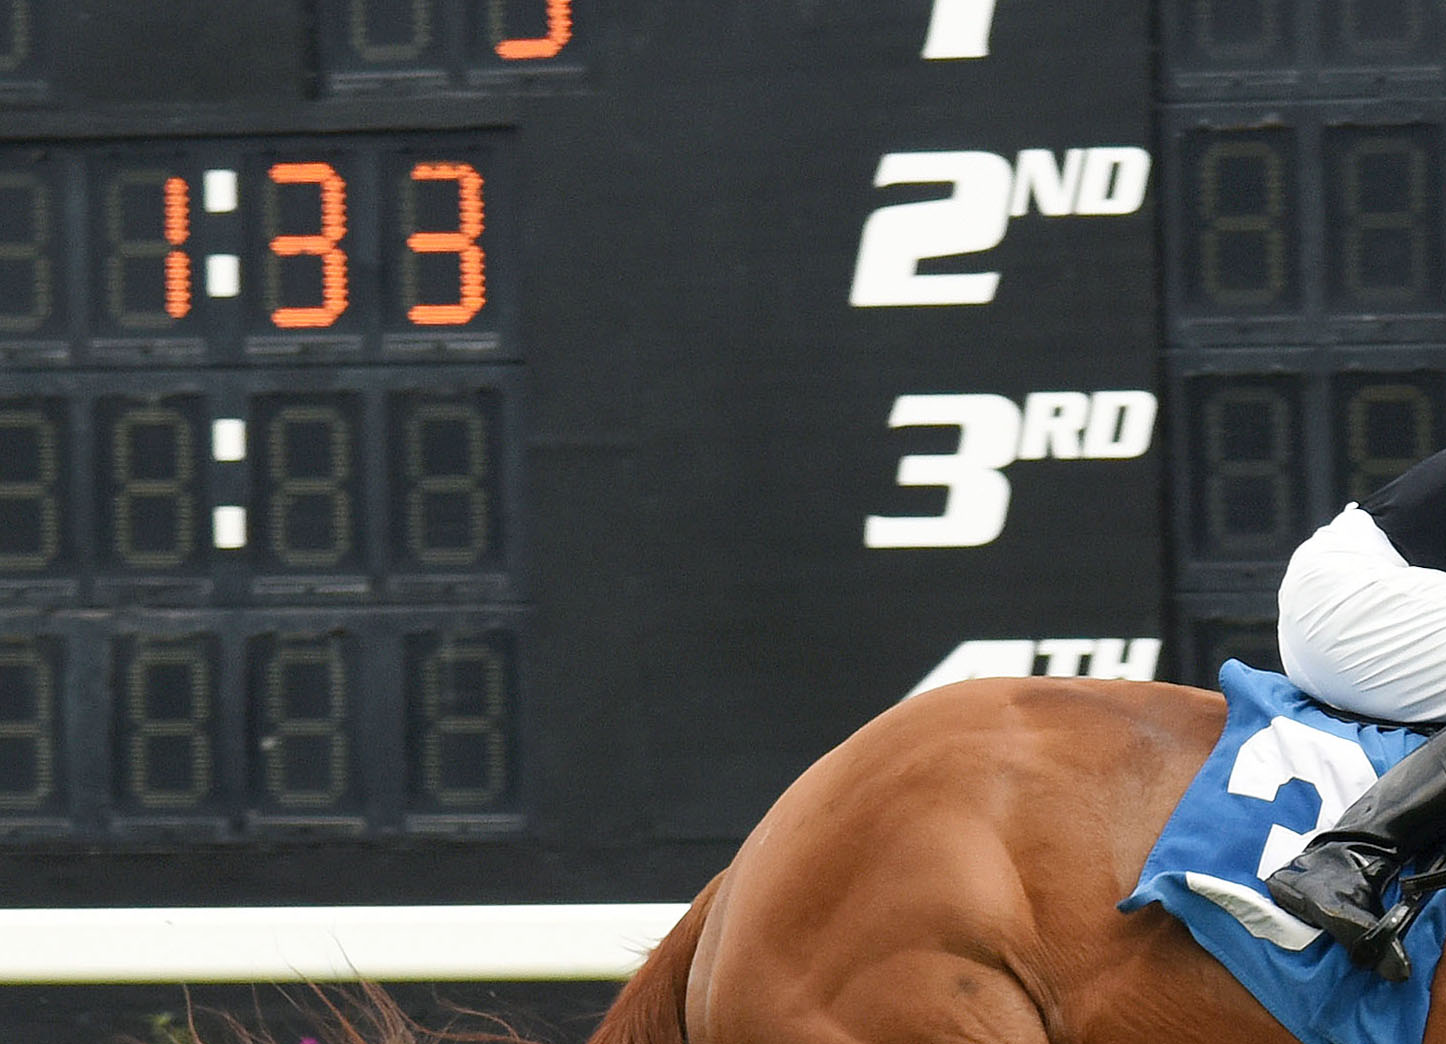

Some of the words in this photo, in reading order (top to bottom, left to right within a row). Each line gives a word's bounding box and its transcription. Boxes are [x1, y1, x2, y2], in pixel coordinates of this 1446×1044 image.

[163, 161, 487, 329] 1:33
[849, 146, 1152, 308] 2ND
[863, 390, 1159, 550] 3RD
[1186, 715, 1379, 952] 3
